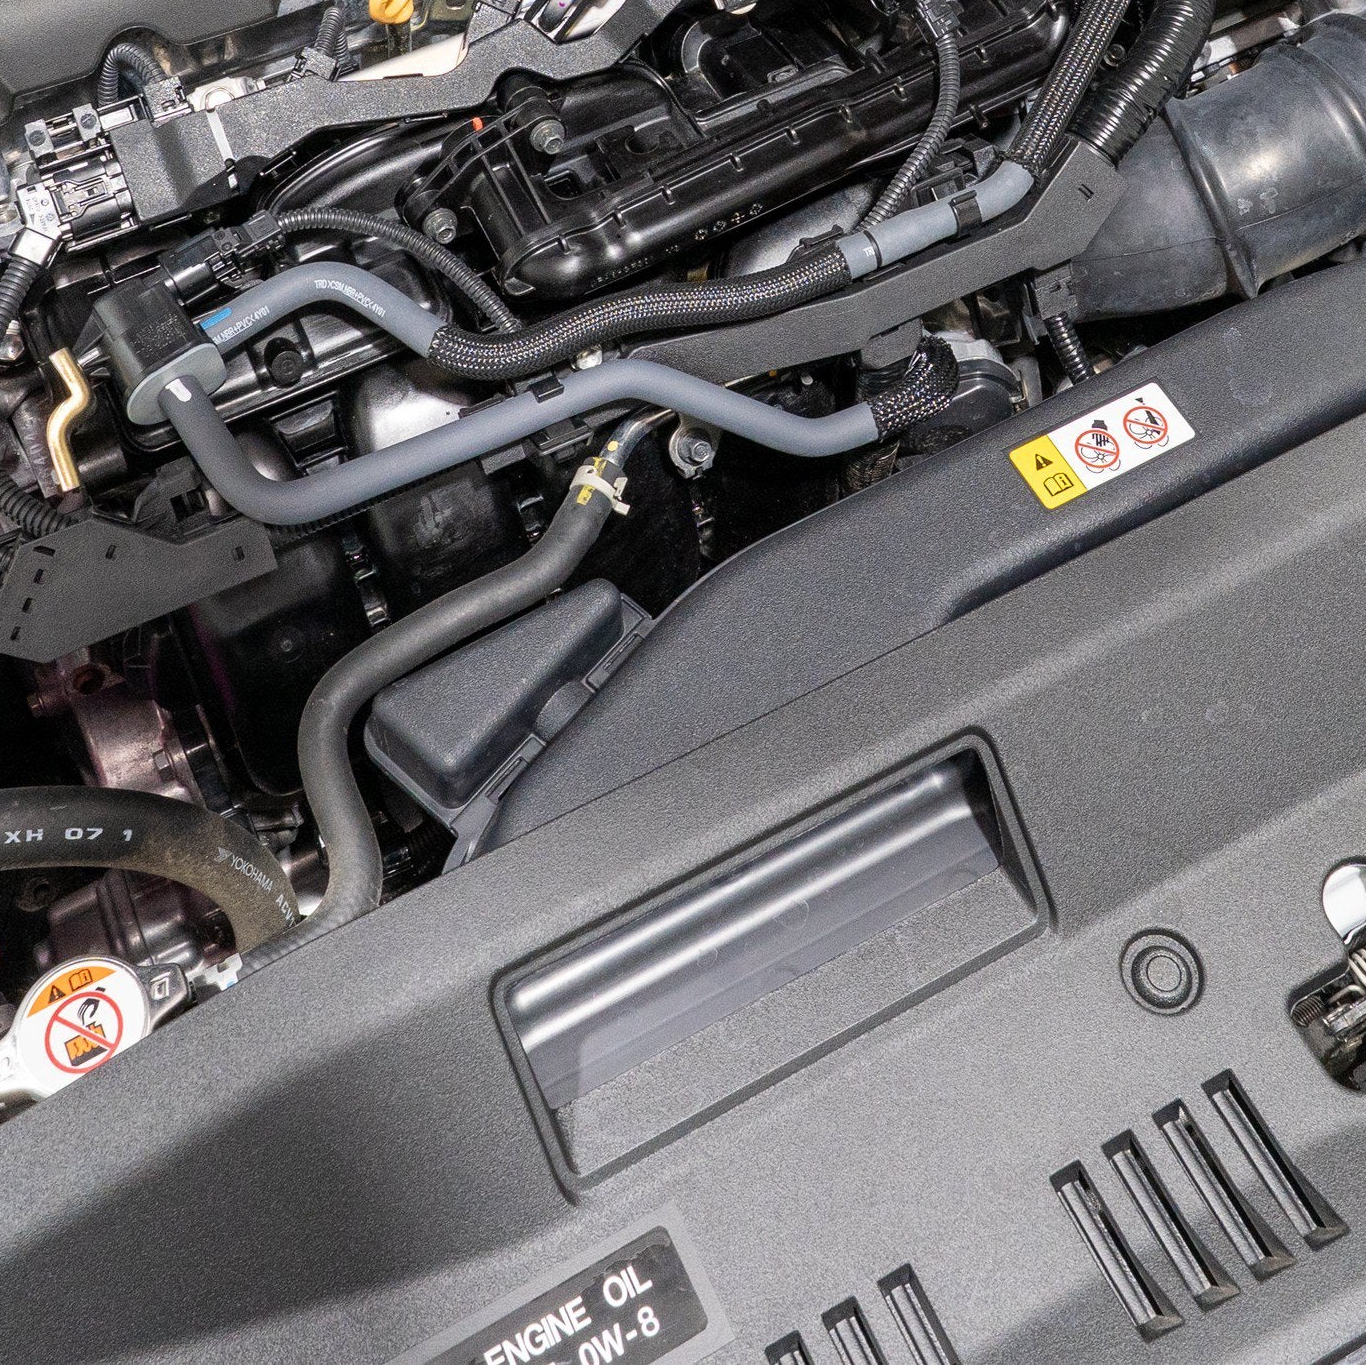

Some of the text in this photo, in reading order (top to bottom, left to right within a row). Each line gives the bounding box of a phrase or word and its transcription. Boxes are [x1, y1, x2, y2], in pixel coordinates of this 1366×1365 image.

[4, 828, 45, 846] XH
[63, 826, 104, 842] 07
[122, 828, 134, 843] 1
[230, 854, 274, 893] YOKOHAMA
[483, 1265, 653, 1365] ENGINE OIL
[578, 1305, 661, 1365] 0W-8
